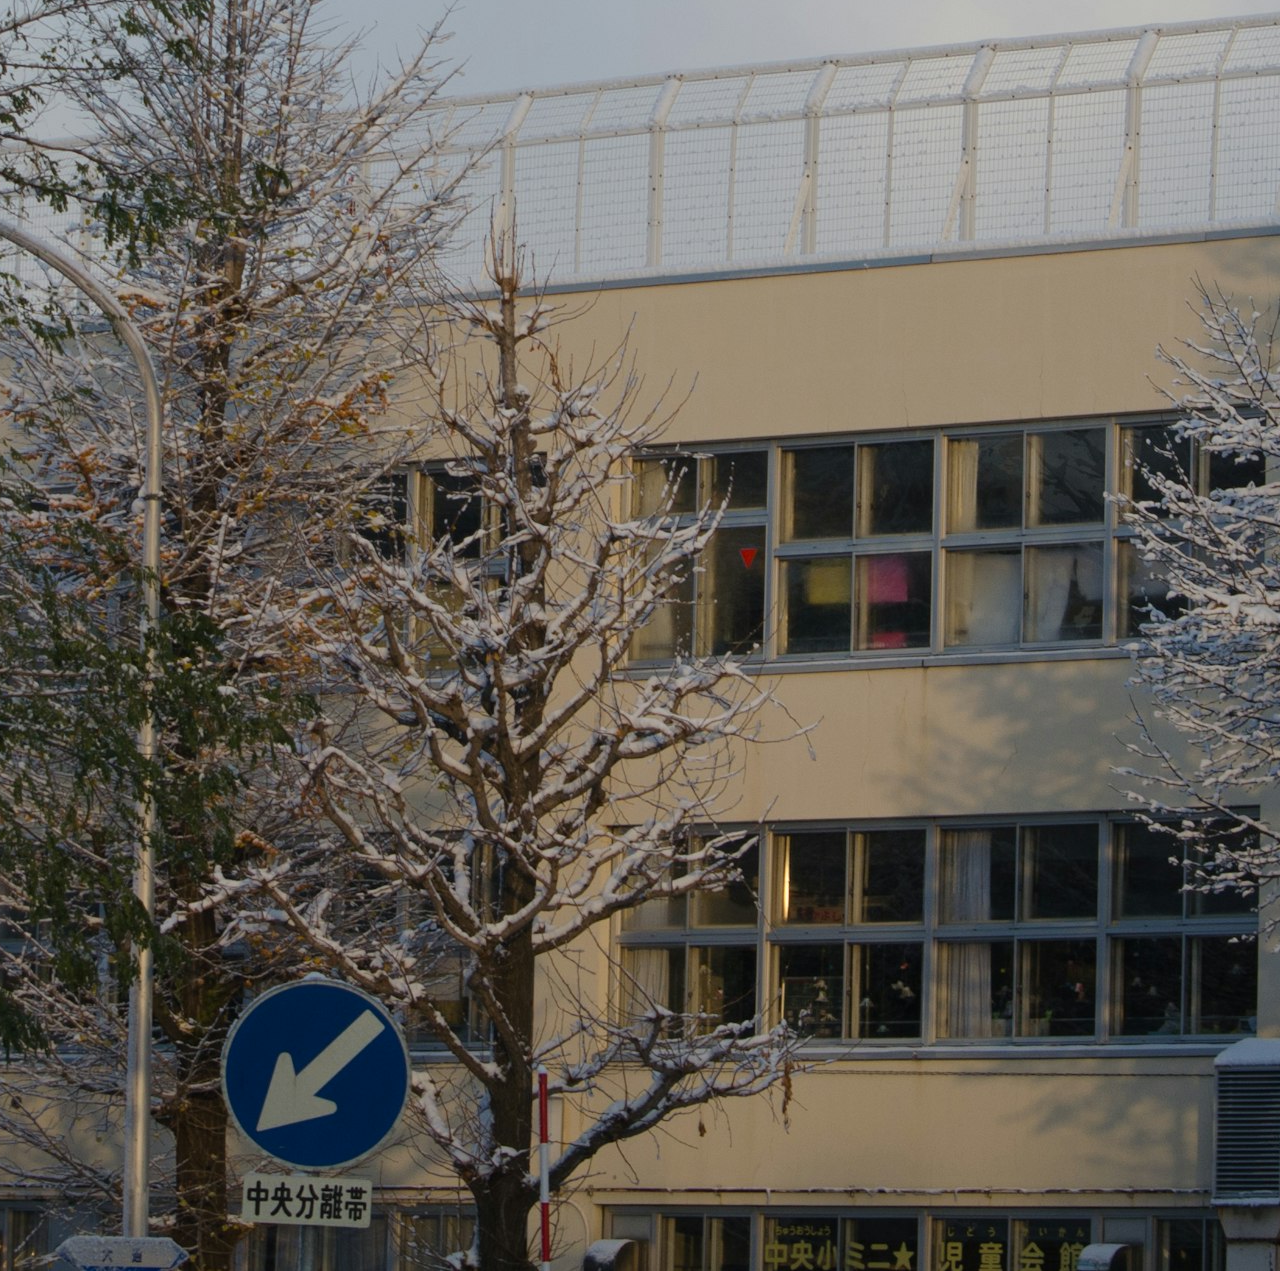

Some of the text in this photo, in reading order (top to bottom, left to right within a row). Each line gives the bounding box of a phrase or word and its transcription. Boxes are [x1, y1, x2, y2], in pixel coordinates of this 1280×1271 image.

[247, 1180, 368, 1221] 中央分離帯
